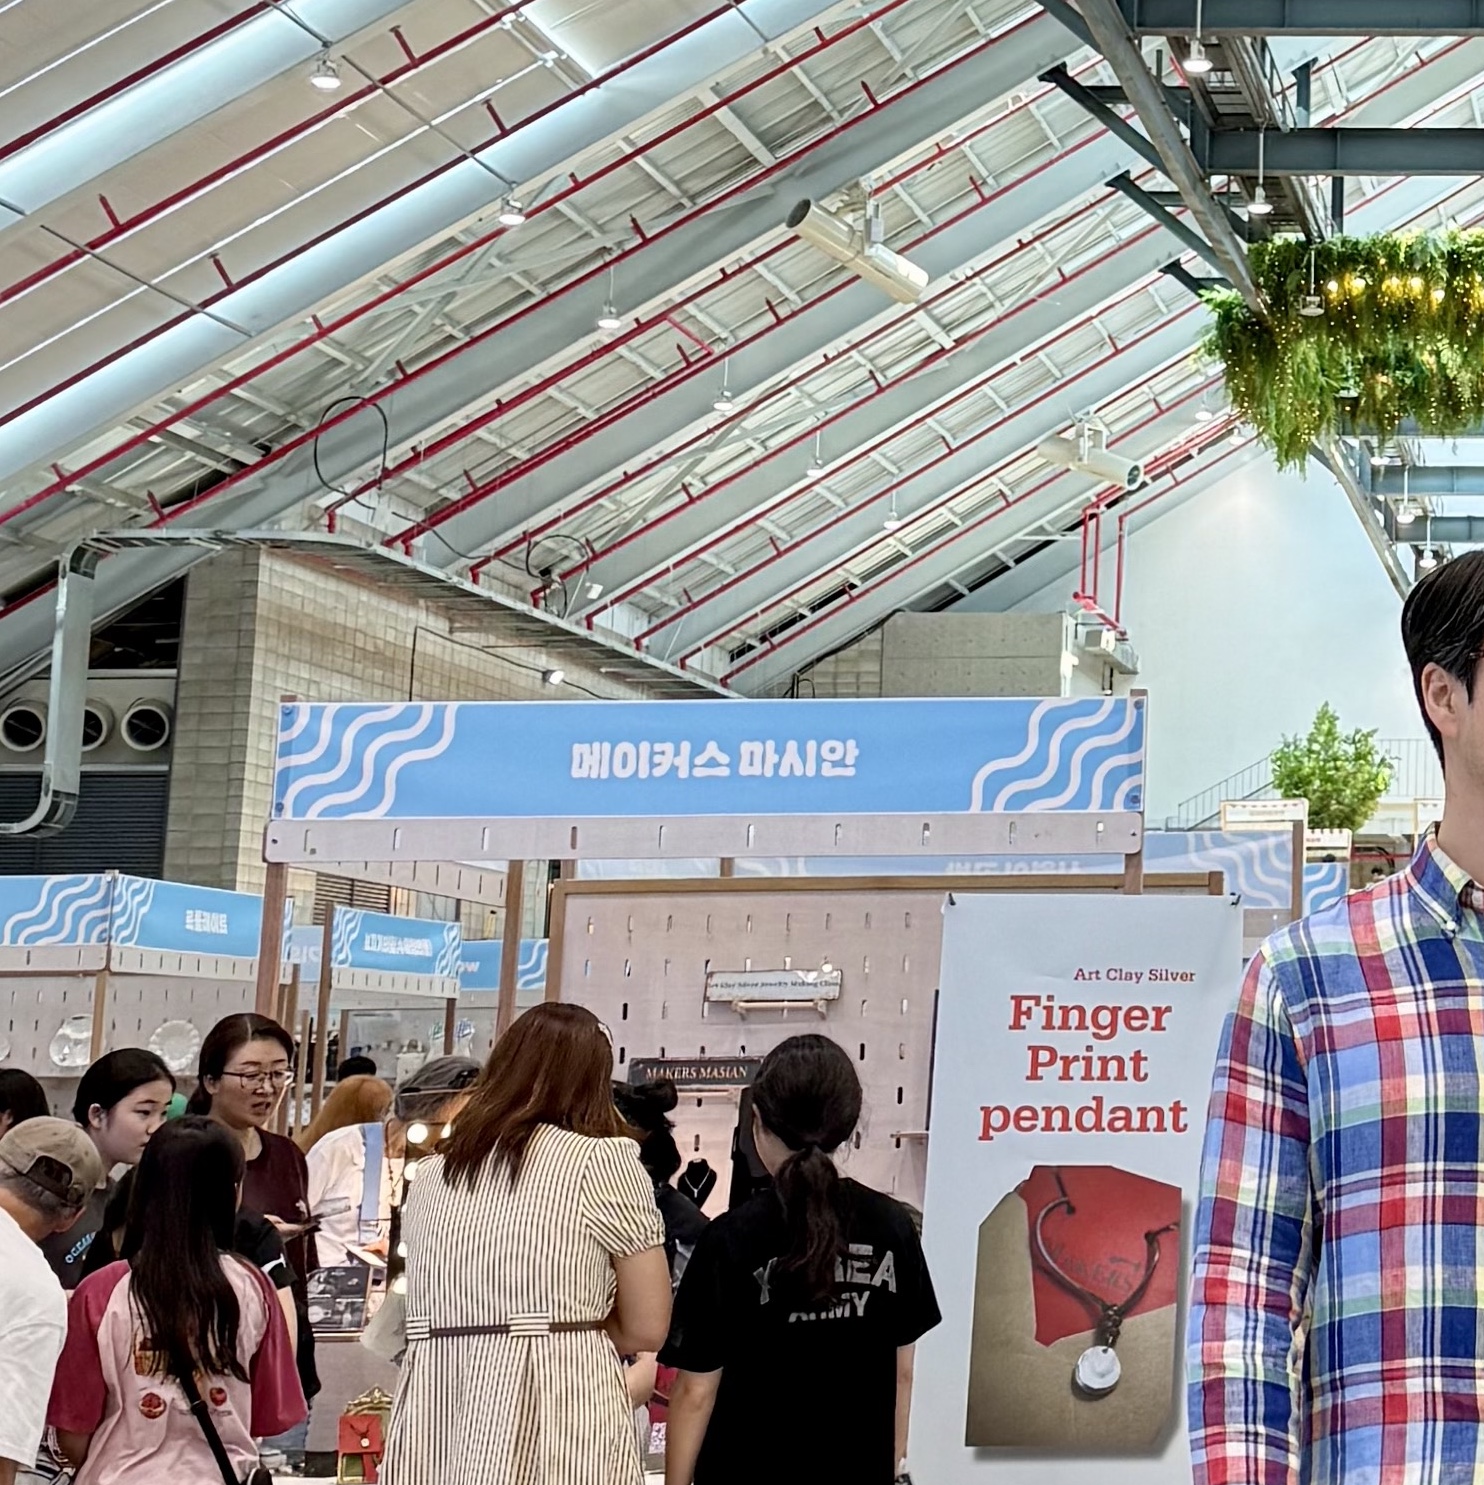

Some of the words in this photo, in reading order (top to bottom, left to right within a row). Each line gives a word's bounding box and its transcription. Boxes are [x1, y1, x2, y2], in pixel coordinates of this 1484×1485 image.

[570, 741, 731, 779] 메이커스
[738, 739, 859, 779] 마시안
[1073, 967, 1101, 982] Art
[1106, 967, 1143, 985] Clay
[1148, 967, 1196, 982] Silver
[1008, 994, 1172, 1041] Finger
[646, 1066, 696, 1080] MAKERS
[698, 1065, 748, 1080] MASIAN
[1025, 1044, 1149, 1083] Print
[977, 1095, 1188, 1142] pendant
